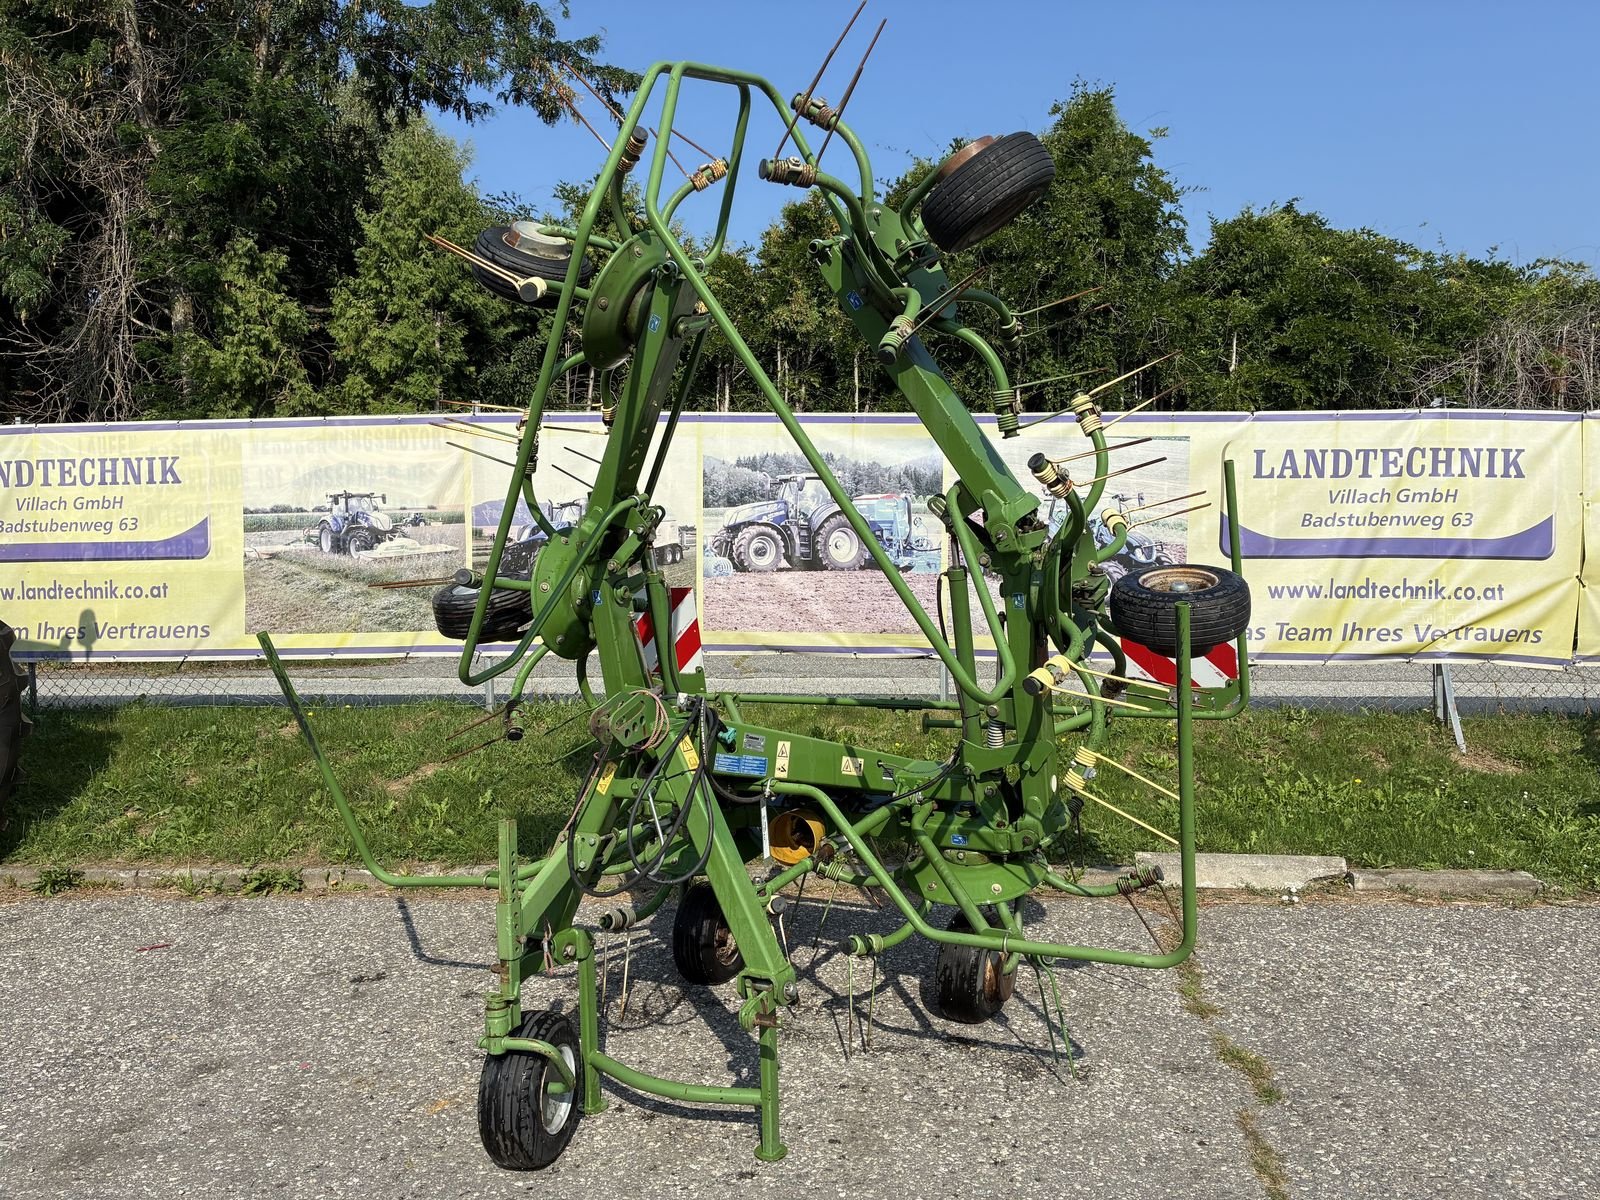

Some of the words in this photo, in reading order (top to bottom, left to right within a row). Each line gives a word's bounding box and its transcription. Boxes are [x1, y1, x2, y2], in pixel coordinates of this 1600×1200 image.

[1252, 446, 1526, 479] LANDTECHNIK
[15, 496, 68, 511] Villach
[73, 496, 124, 510] GmbH
[1328, 489, 1391, 505] Villach
[1396, 488, 1459, 504] GmbH
[119, 517, 139, 531] 63
[1300, 512, 1444, 530] Badstubenweg
[1451, 512, 1474, 528] 63
[1267, 577, 1504, 601] www.landtechnik.co.at
[36, 622, 87, 641] Ihres
[94, 621, 210, 640] Vertrauens
[1246, 627, 1266, 642] as
[1275, 622, 1333, 642] Team
[1341, 621, 1403, 643] Ihres
